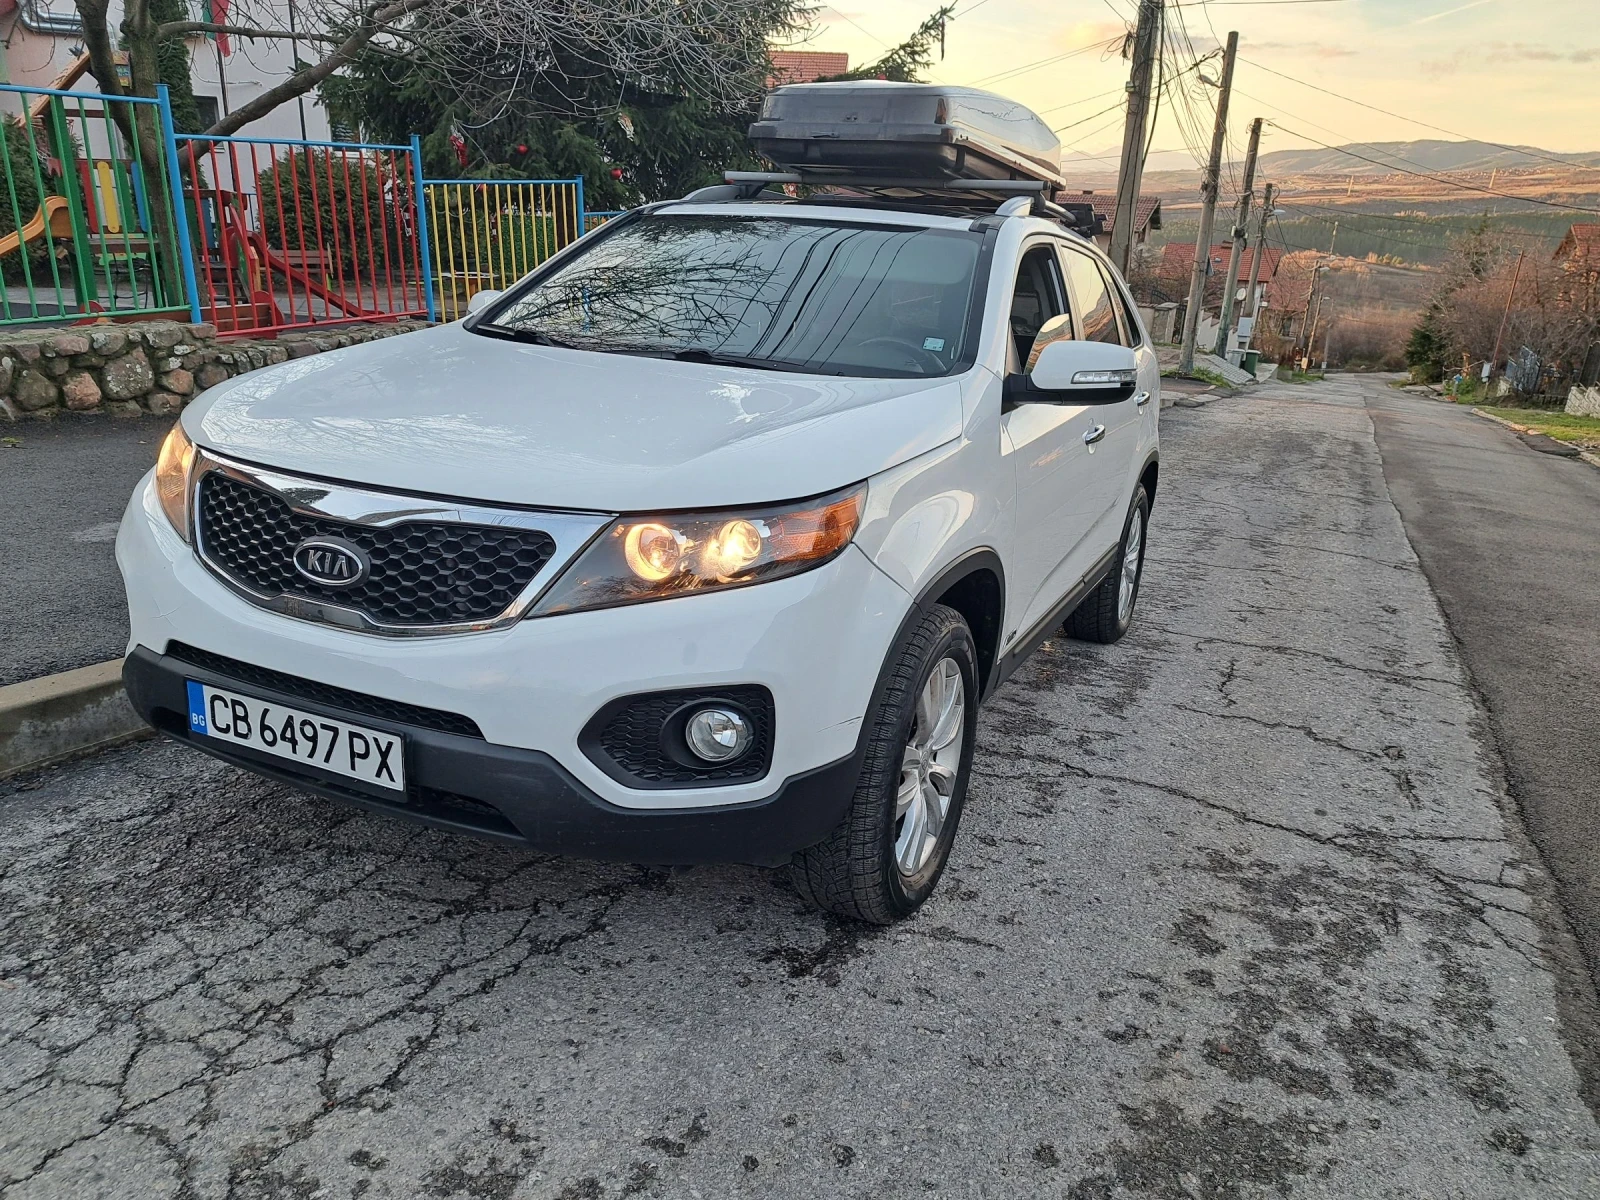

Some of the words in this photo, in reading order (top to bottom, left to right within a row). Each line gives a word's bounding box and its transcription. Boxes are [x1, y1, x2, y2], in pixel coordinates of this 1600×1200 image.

[307, 549, 348, 577] KIA
[192, 712, 205, 727] BG
[209, 694, 252, 740] CB
[259, 708, 340, 763] 6497
[347, 730, 396, 783] PX
